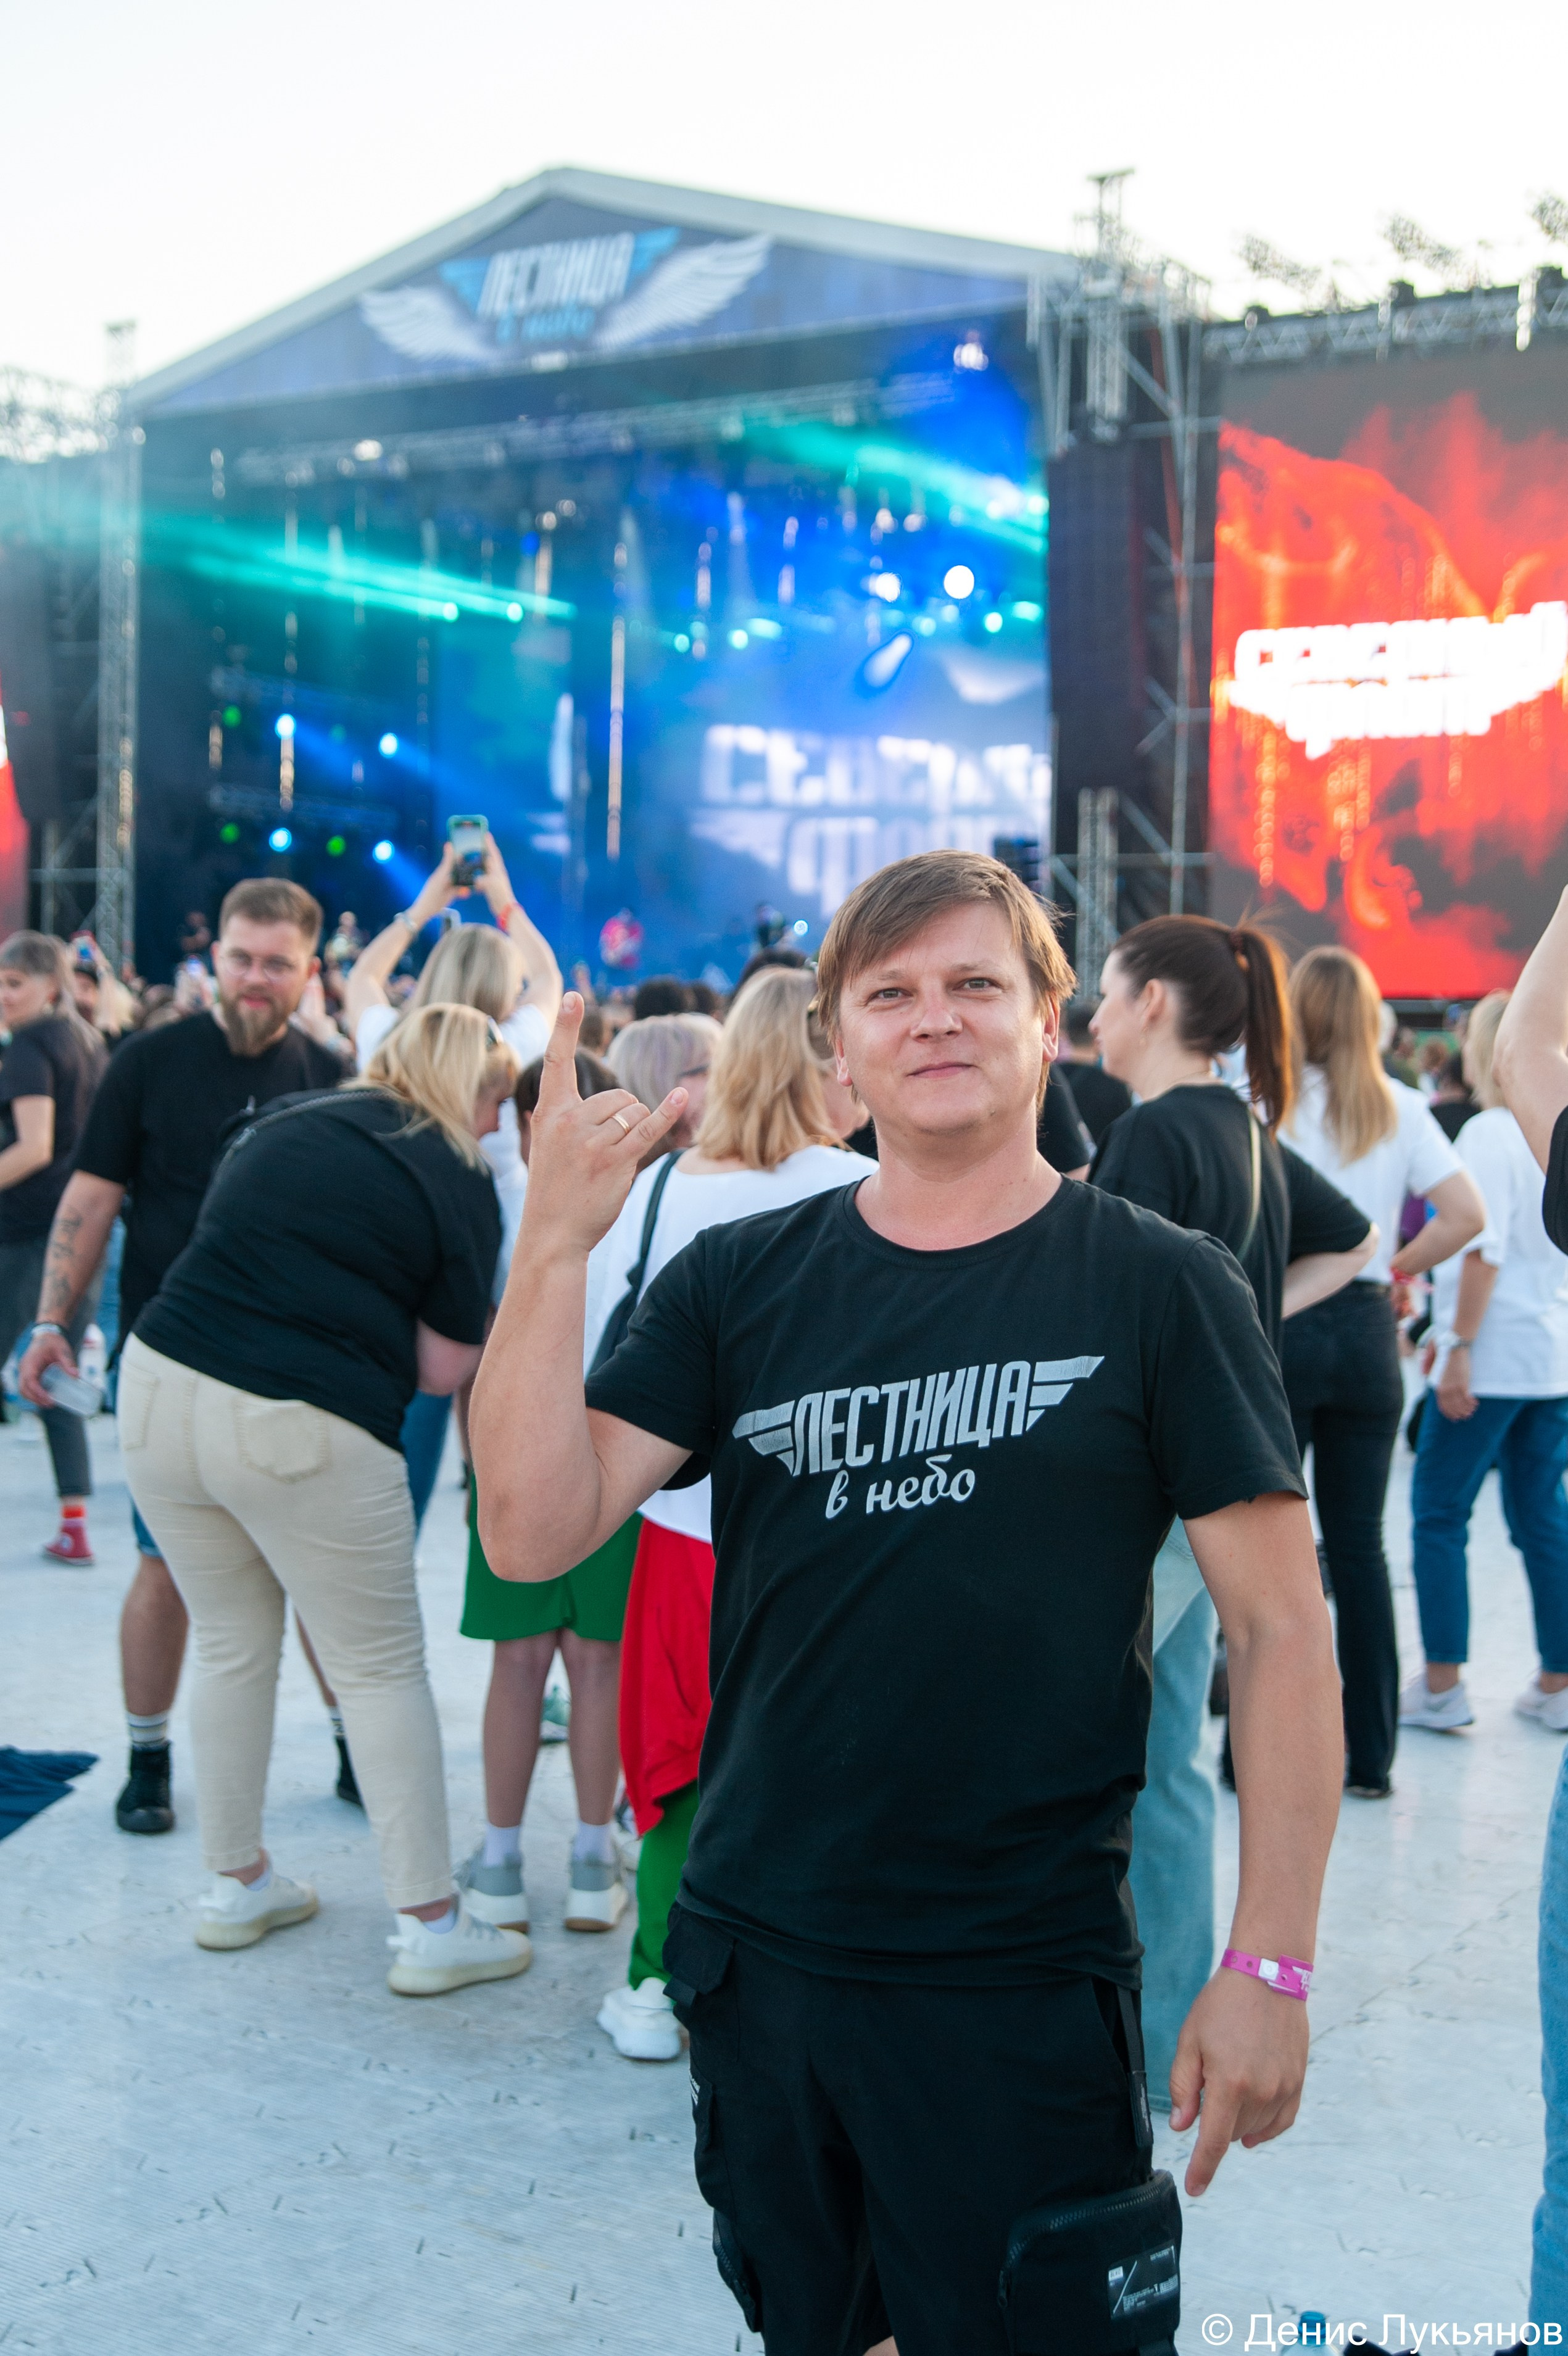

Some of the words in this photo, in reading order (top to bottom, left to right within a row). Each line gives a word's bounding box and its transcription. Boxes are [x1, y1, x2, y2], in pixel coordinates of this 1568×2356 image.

[792, 1361, 1031, 1477] ЛЕСТНИЦА
[824, 1470, 849, 1520] в
[865, 1453, 976, 1515] небо
